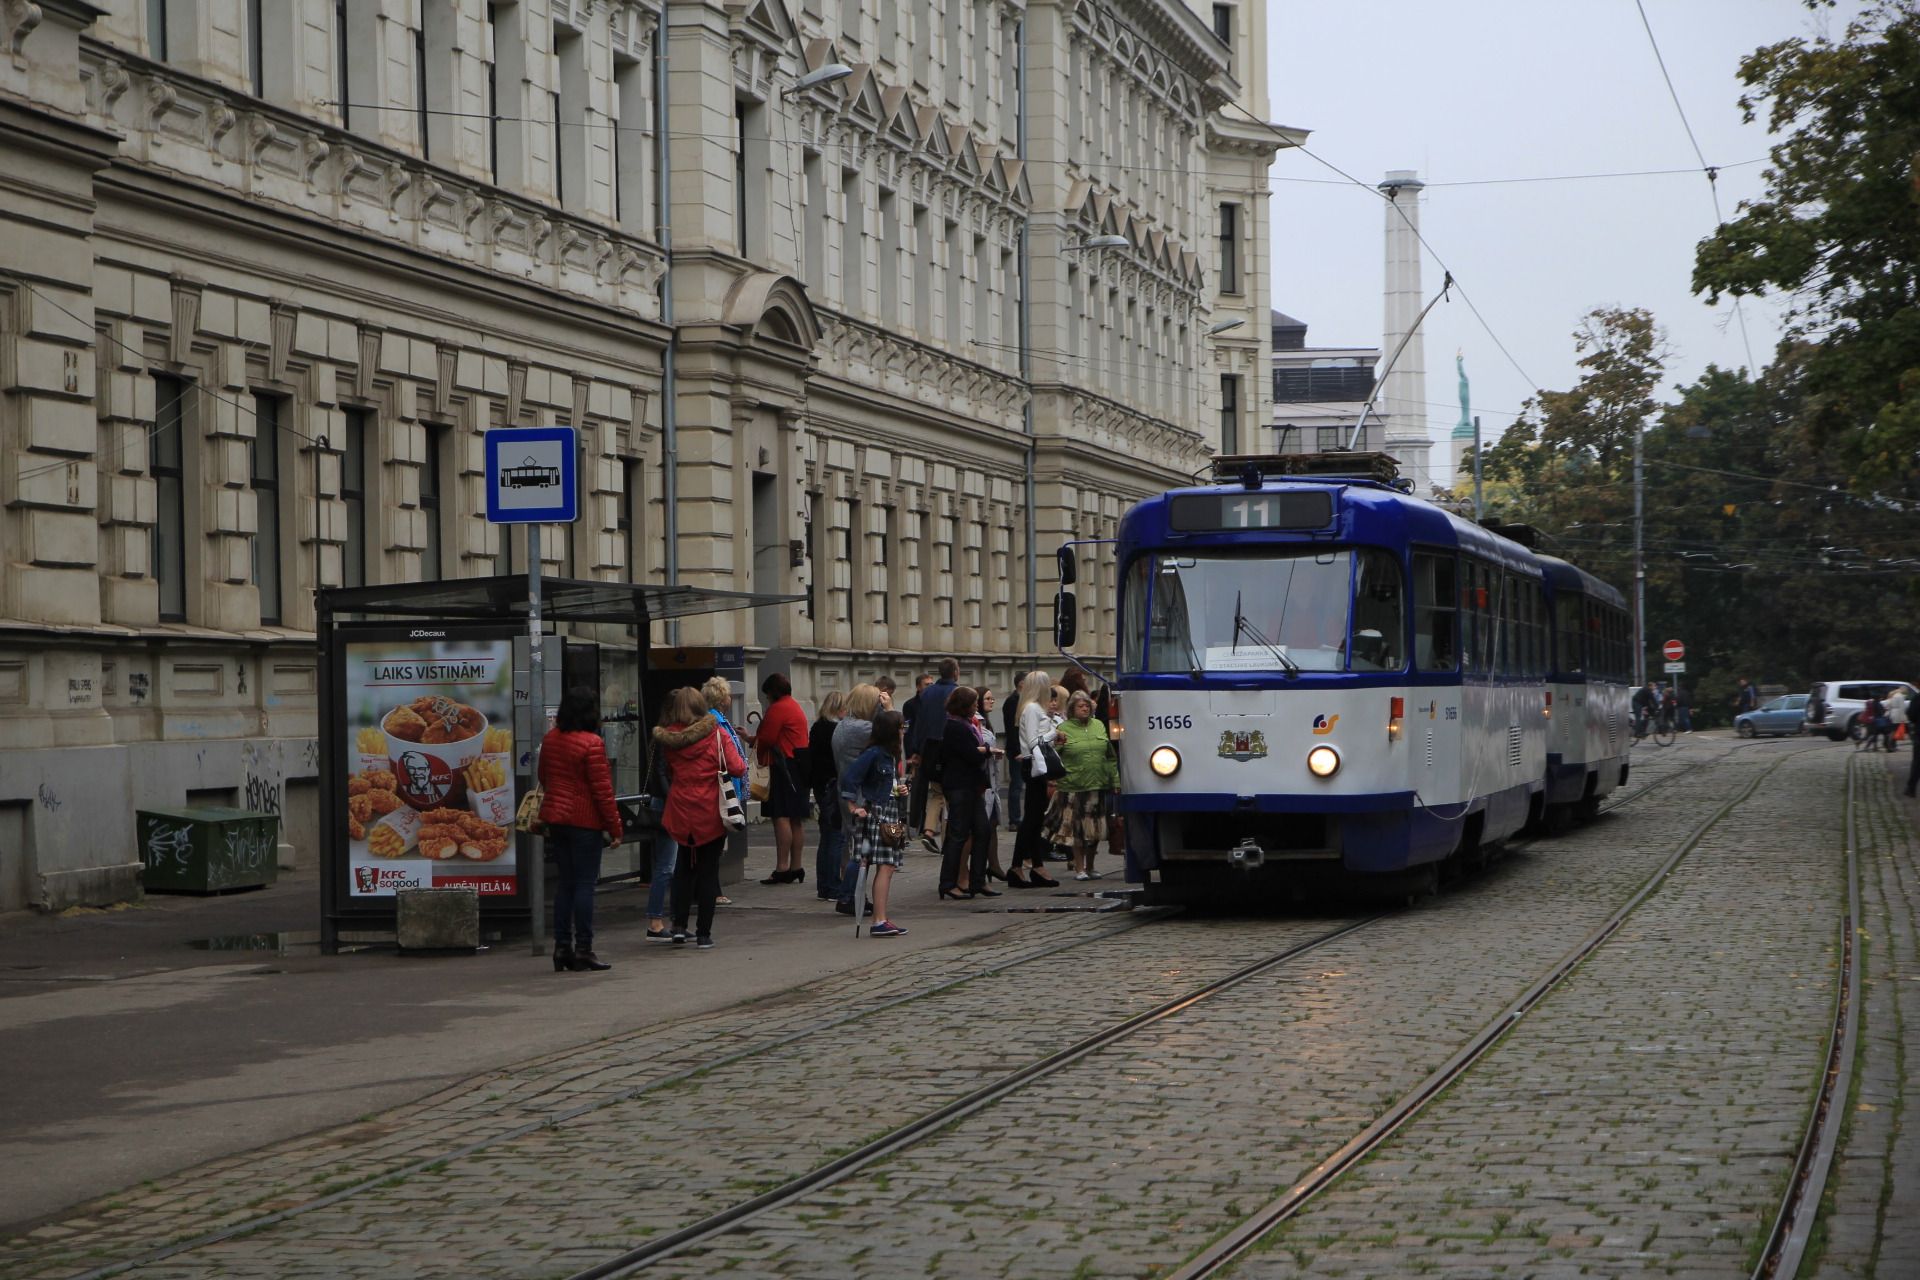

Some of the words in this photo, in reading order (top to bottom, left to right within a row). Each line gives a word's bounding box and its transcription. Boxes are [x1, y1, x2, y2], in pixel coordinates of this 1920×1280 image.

[1232, 500, 1269, 527] 11
[409, 629, 446, 637] JCDecaux
[374, 666, 413, 680] LAIKS
[415, 662, 485, 681] VISTIŅĀM!
[1148, 714, 1192, 730] 51656
[431, 773, 450, 781] KFC
[381, 870, 407, 879] KFC
[379, 877, 420, 889] sogood
[480, 880, 501, 892] IELĀ
[502, 882, 511, 892] 14
